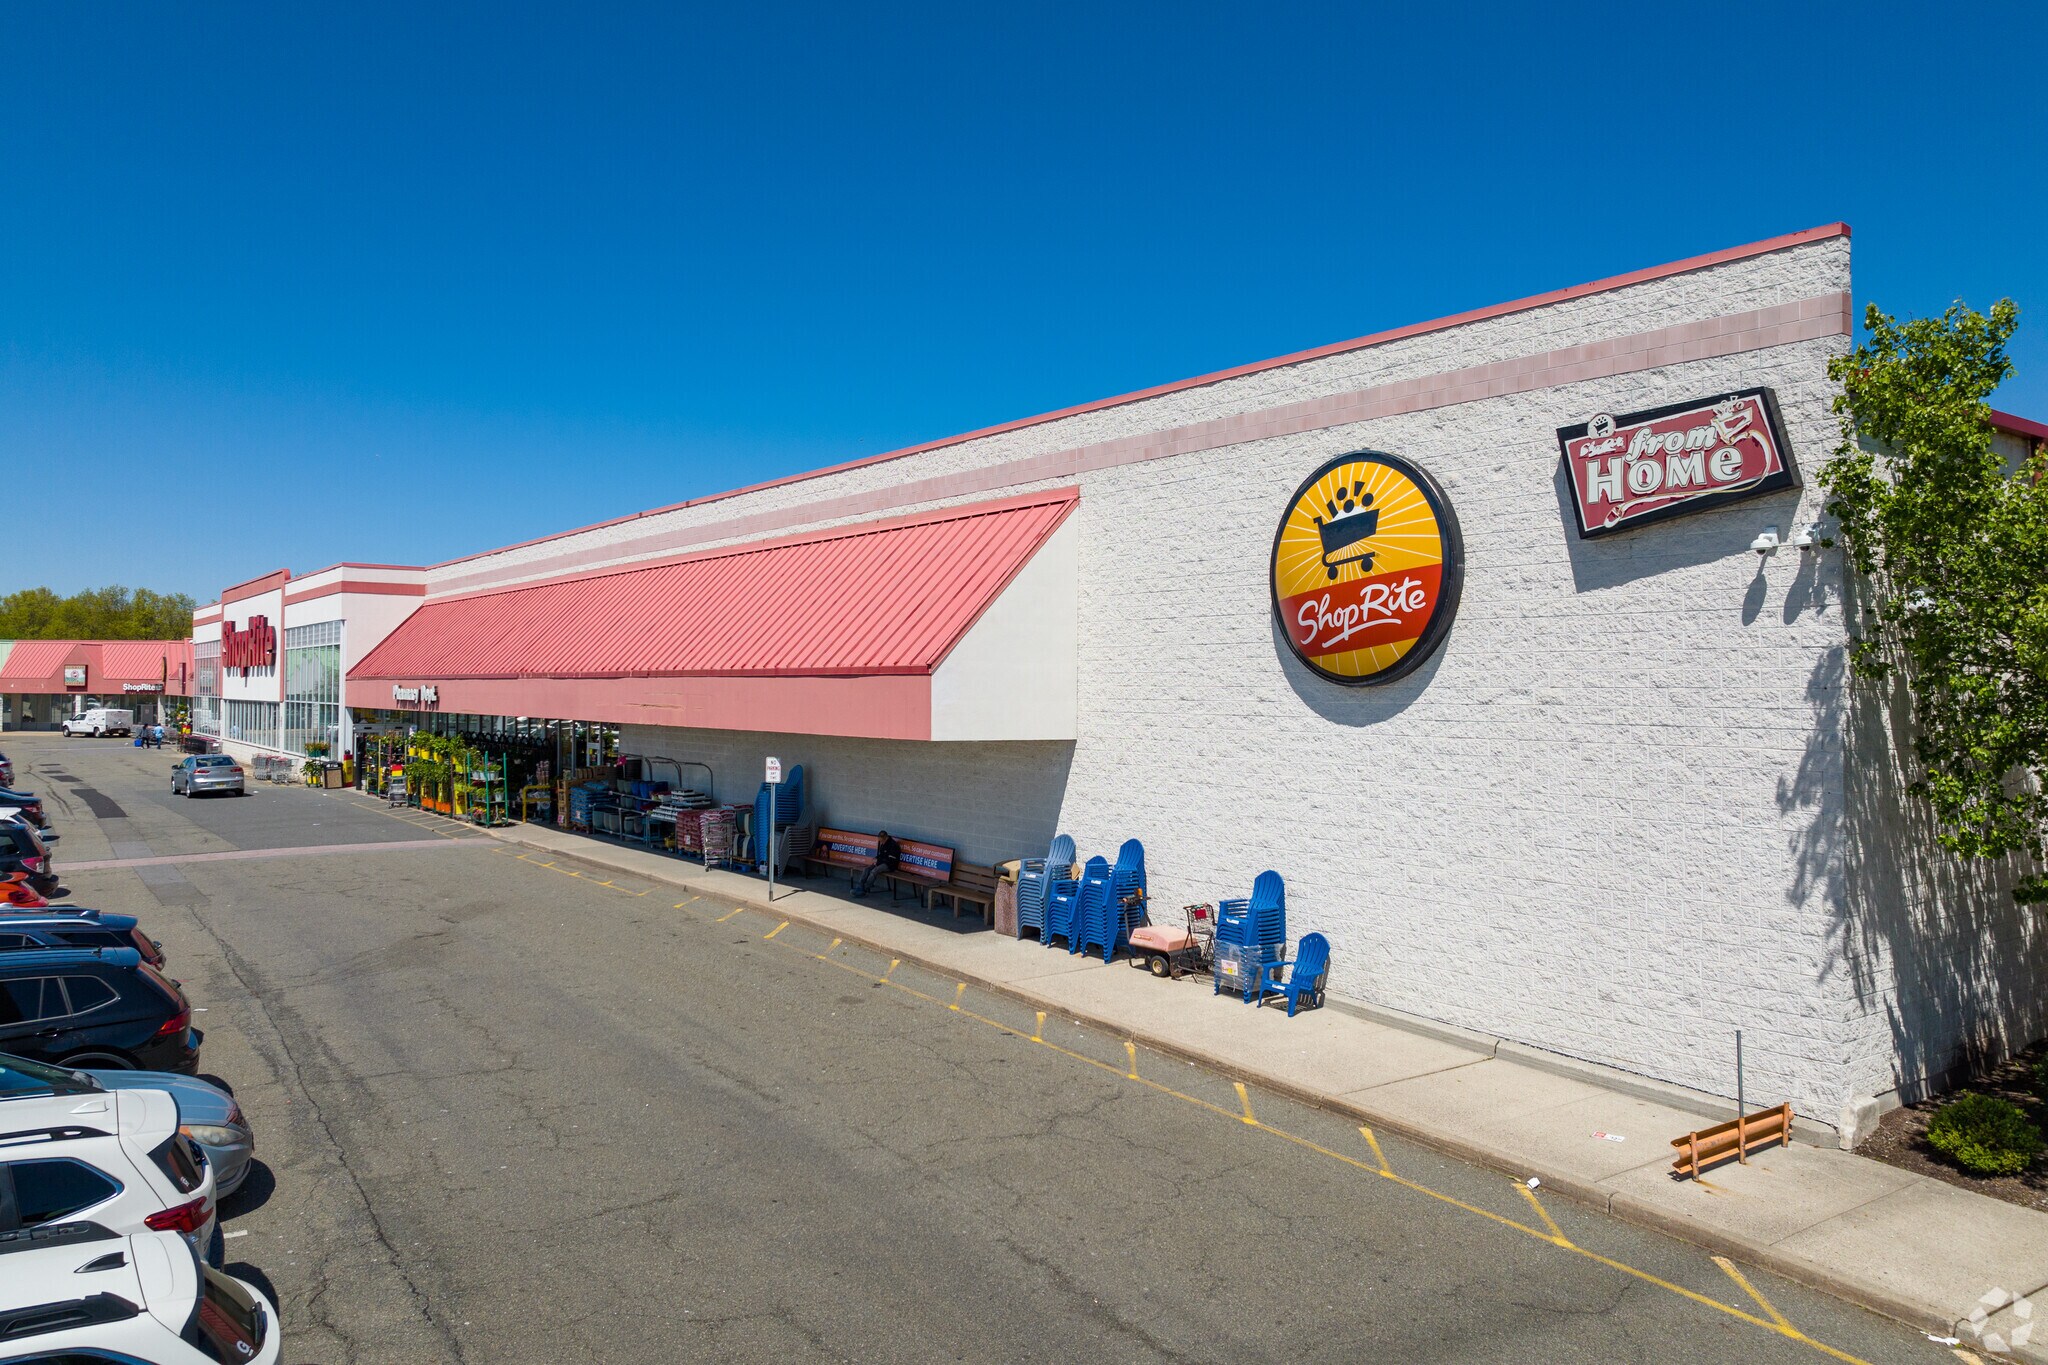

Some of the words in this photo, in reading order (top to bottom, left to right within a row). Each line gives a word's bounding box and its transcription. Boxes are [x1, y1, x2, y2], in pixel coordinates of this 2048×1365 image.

[1625, 426, 1718, 462] from
[1298, 577, 1427, 648] ShopRite
[122, 683, 155, 692] ShopRite
[831, 842, 854, 854] ADVERTISE
[855, 846, 867, 856] HERE
[900, 853, 923, 865] DVERTISE
[924, 858, 938, 869] HERE
